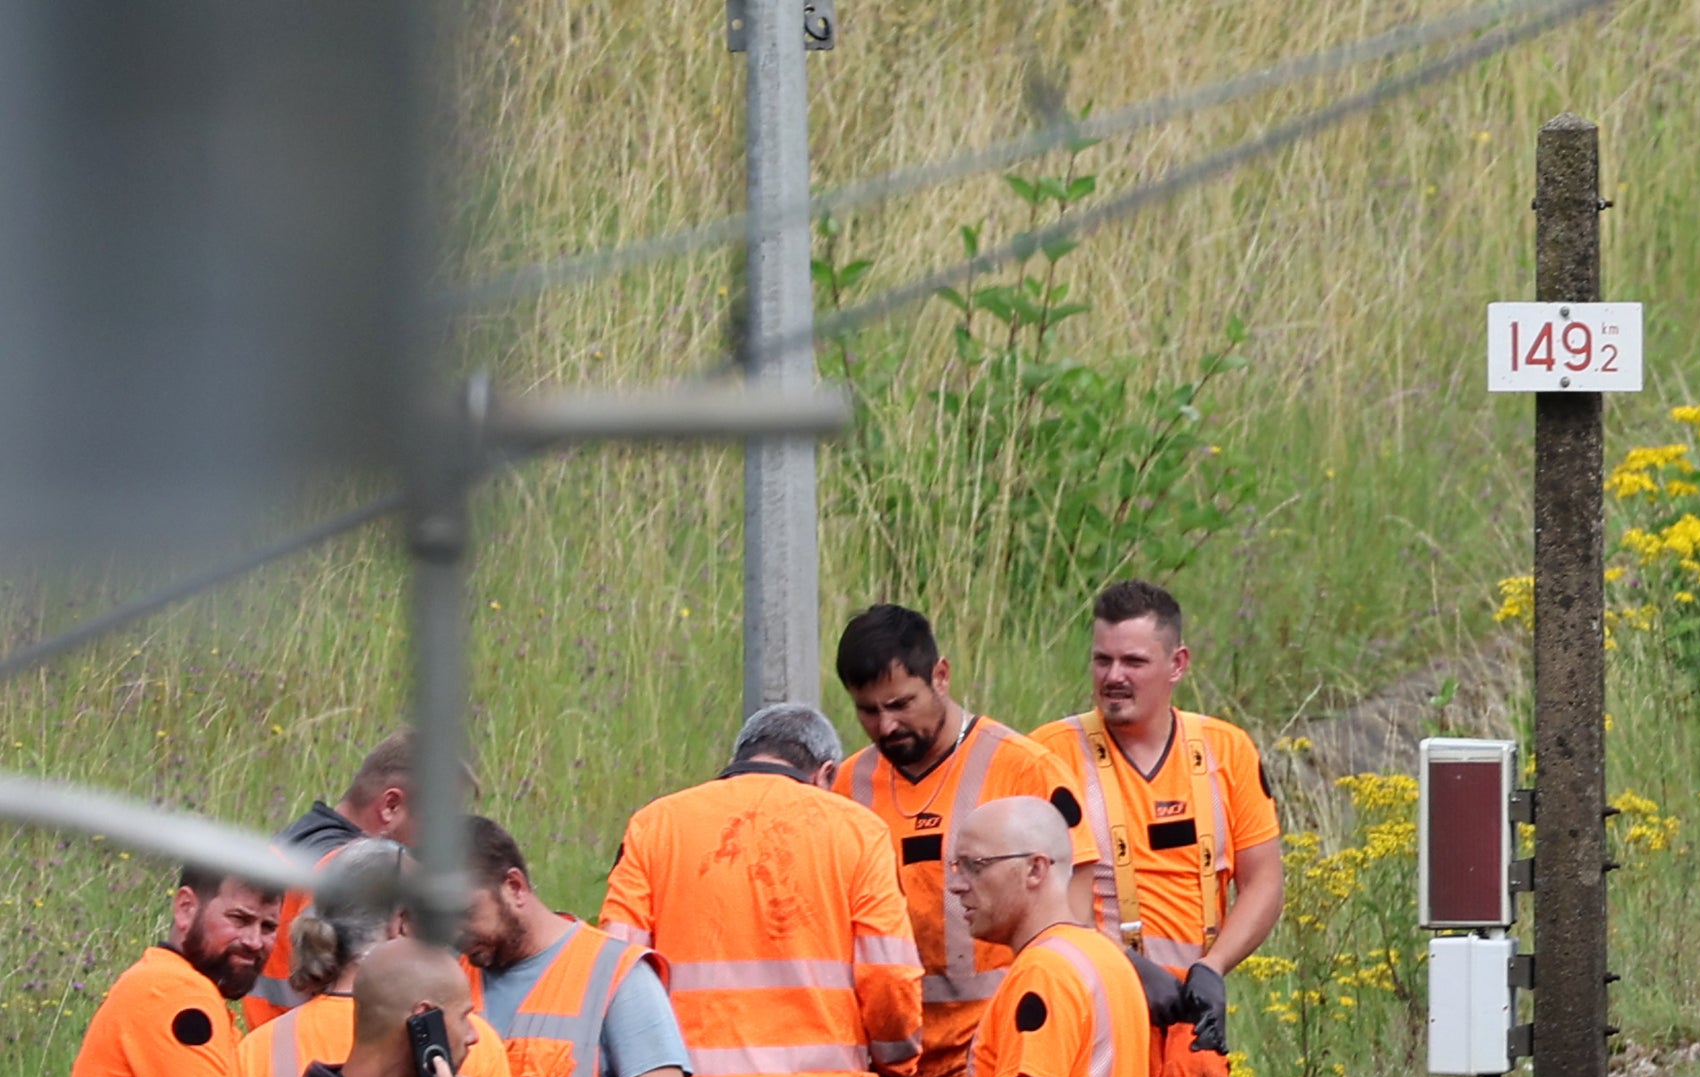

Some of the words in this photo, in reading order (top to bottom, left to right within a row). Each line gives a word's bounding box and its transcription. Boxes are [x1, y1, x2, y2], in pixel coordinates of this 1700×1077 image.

[1601, 322, 1620, 335] km
[1511, 321, 1592, 372] 149
[1156, 801, 1186, 817] SNCF
